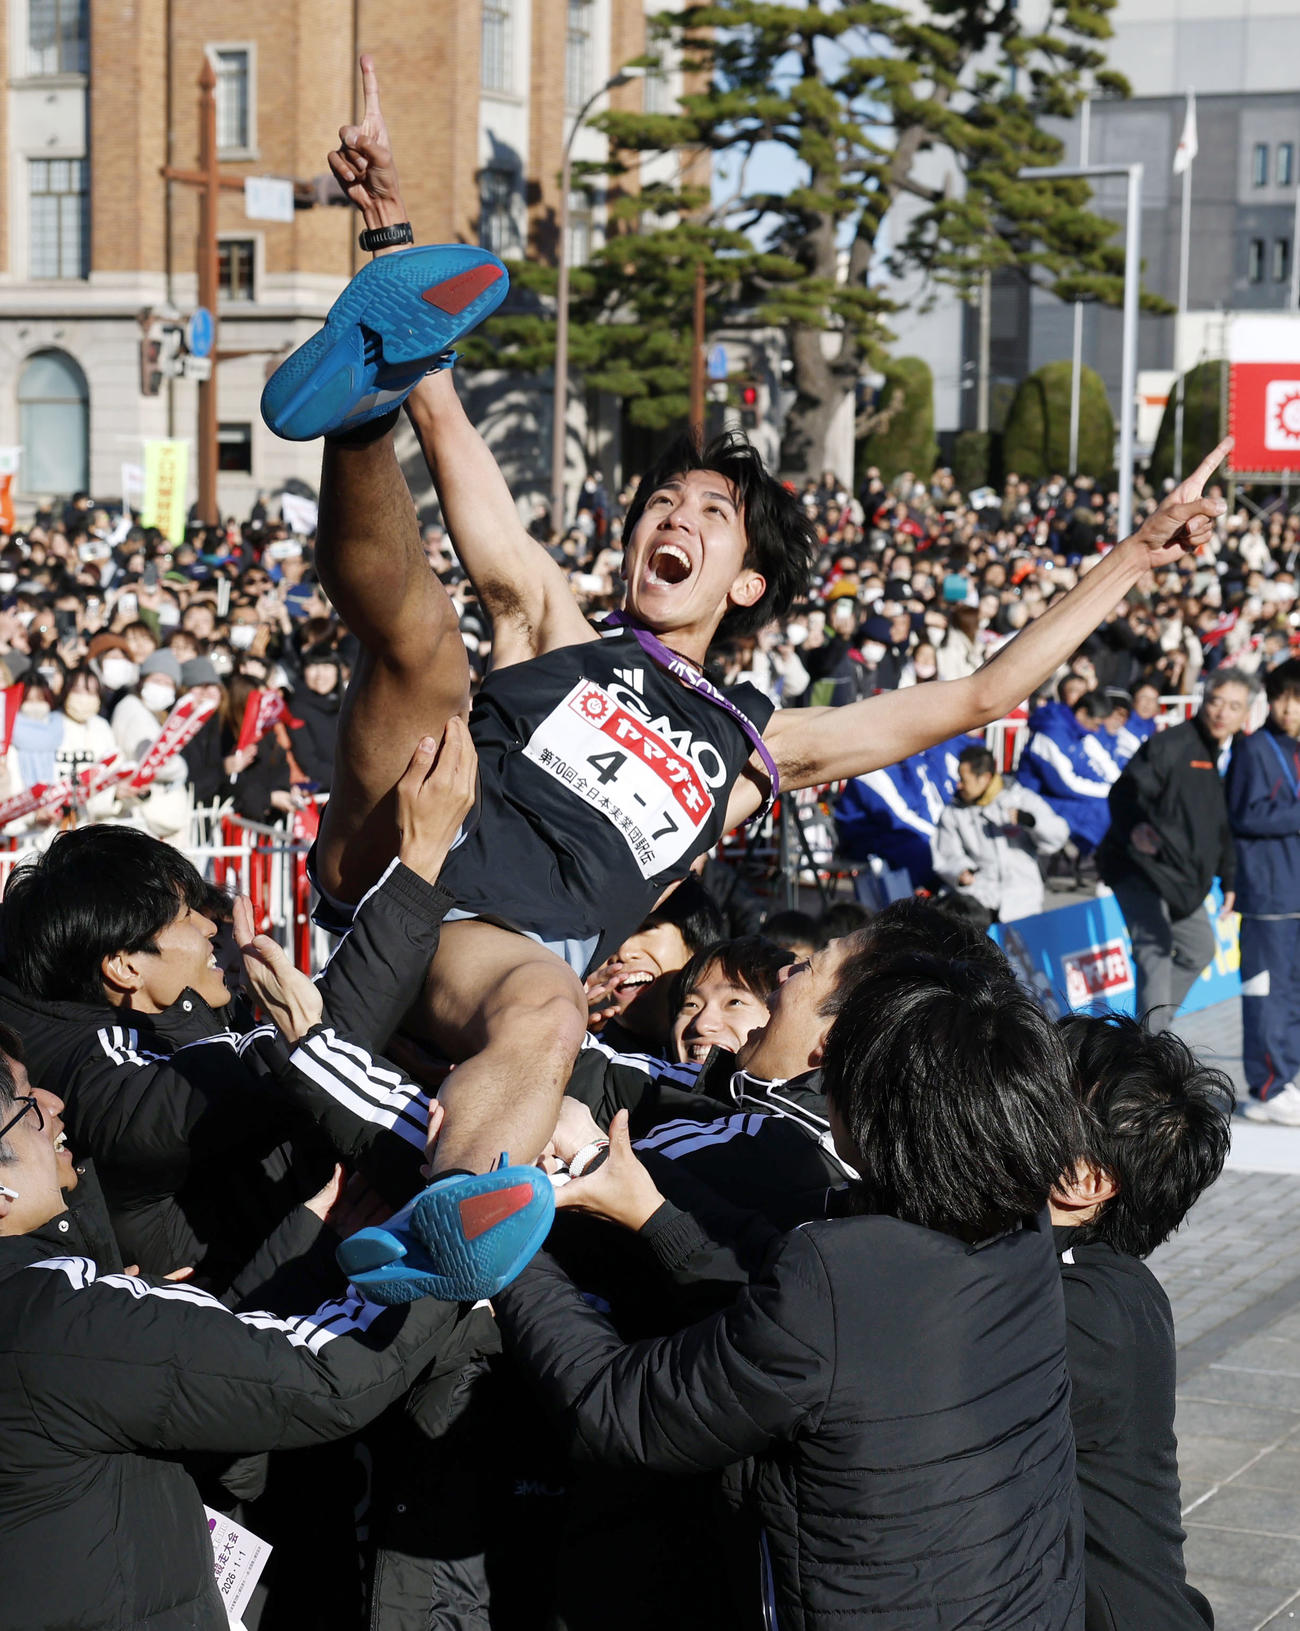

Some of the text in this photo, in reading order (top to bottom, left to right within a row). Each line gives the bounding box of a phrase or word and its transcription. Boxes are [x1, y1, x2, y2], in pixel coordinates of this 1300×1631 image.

[606, 683, 727, 789] GMO
[616, 717, 705, 814] ヤマザキ
[538, 748, 656, 865] 第70回全日本実業団駅伝
[214, 1532, 239, 1582] 競走大会
